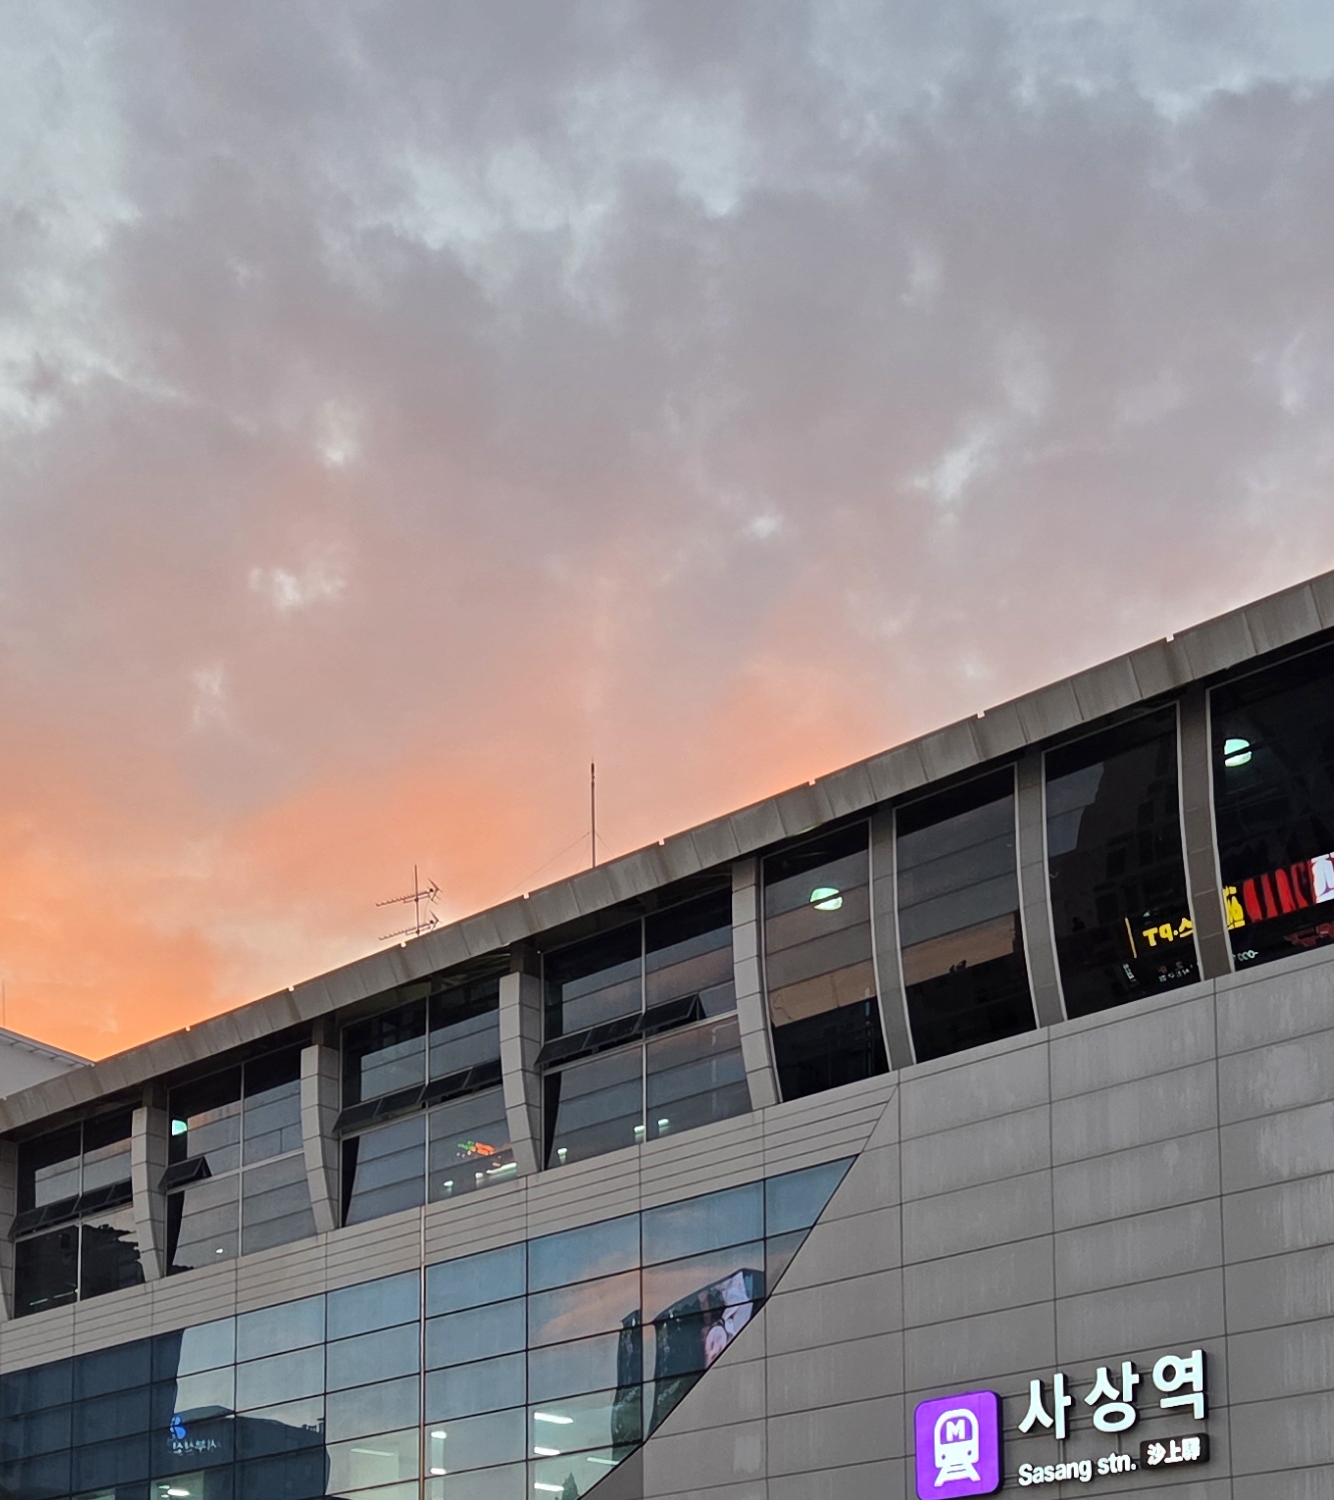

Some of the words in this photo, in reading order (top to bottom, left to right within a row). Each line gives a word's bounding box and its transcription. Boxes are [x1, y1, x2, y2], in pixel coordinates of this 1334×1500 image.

[1018, 1349, 1206, 1440] 사상역
[945, 1418, 966, 1441] M
[1018, 1456, 1093, 1487] Sasang
[1097, 1452, 1137, 1476] stn.
